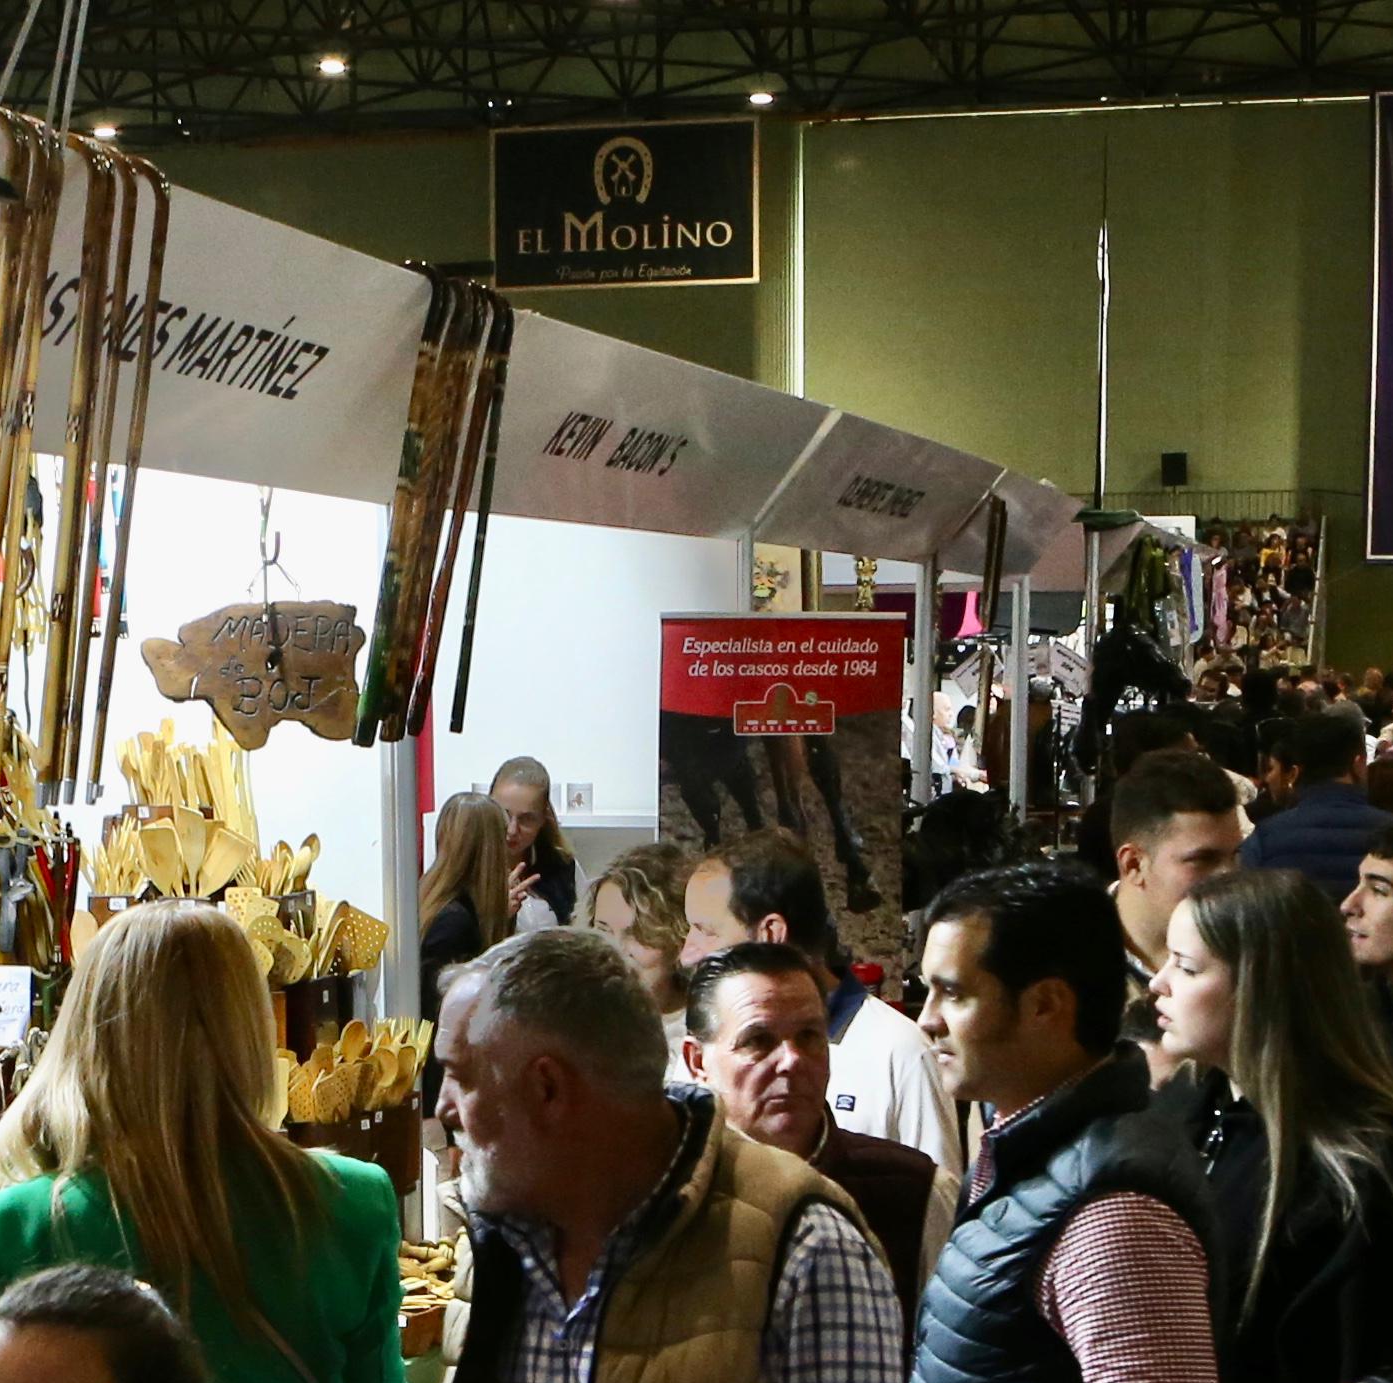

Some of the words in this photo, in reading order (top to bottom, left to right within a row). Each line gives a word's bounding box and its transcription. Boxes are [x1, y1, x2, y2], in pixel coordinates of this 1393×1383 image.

[517, 229, 550, 254] EL
[162, 316, 330, 400] MARTÍNEZ
[543, 411, 614, 461] KEVIN
[683, 637, 773, 657] Especialista
[777, 641, 796, 653] en
[800, 638, 815, 653] el
[818, 637, 879, 654] cuidado
[688, 661, 708, 677] de
[712, 661, 735, 677] los
[738, 664, 789, 676] cascos
[792, 660, 838, 676] desde
[842, 660, 878, 676] 1984
[232, 676, 322, 716] BOJ
